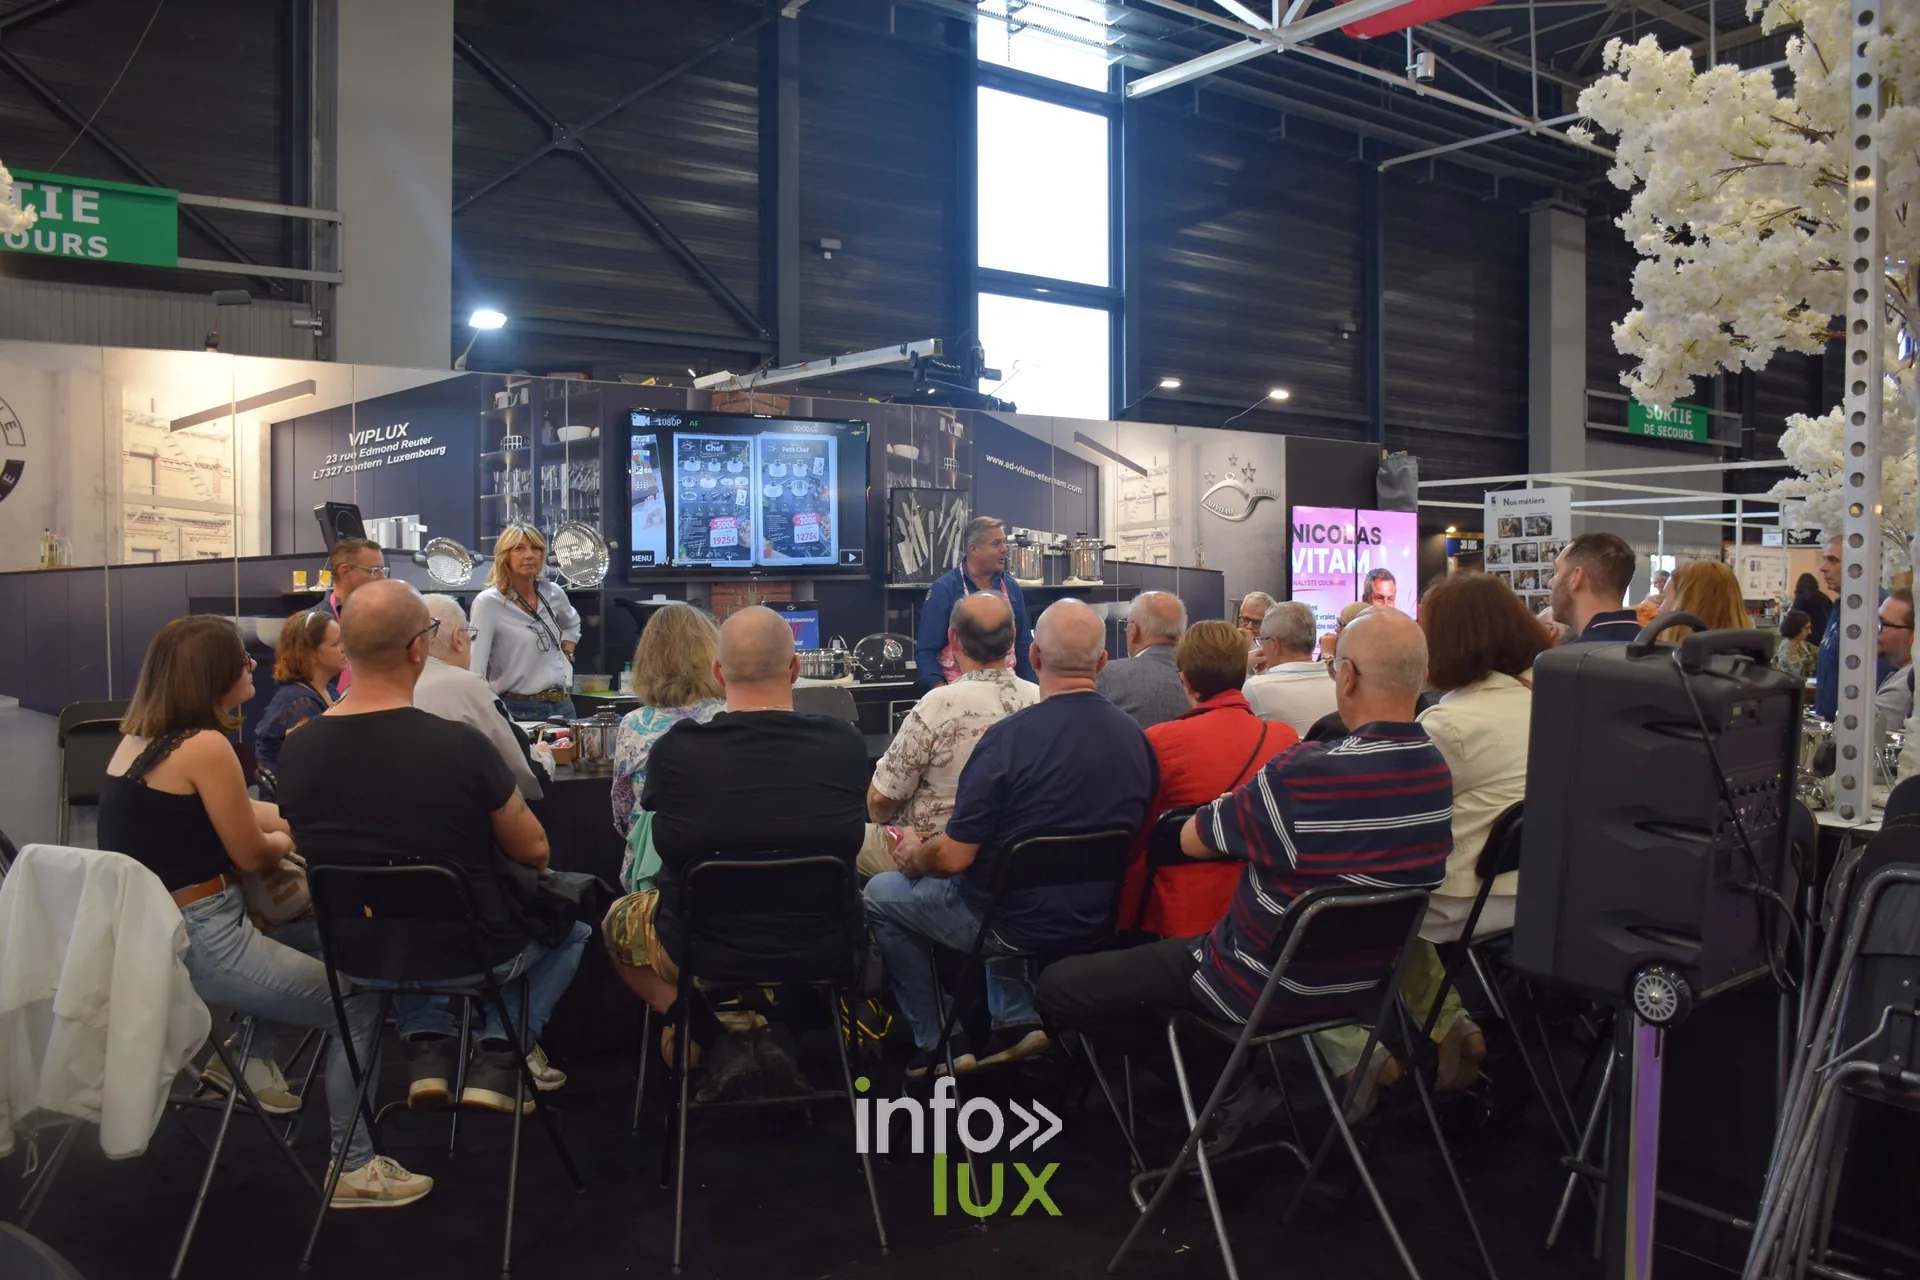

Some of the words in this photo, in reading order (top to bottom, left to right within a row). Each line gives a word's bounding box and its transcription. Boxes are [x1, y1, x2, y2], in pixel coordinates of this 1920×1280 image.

[656, 418, 682, 427] 1080P
[1646, 404, 1692, 425] SORTIE
[348, 422, 410, 446] VIPLUX
[1644, 423, 1655, 435] DE
[1657, 425, 1694, 440] SECOURS
[325, 453, 338, 465] 23
[339, 451, 357, 462] rue
[359, 441, 400, 458] Edmond
[400, 435, 433, 450] Reuter
[705, 444, 724, 452] Chef
[313, 464, 342, 480] L7327
[344, 458, 382, 473] contern
[387, 445, 447, 465] Luxembourg
[986, 454, 1083, 494] www.ad-vitam-eternam.com
[1503, 498, 1517, 506] Nos
[1518, 497, 1545, 506] métiers
[1293, 523, 1382, 545] NICOLAS
[1292, 547, 1370, 574] VITAM
